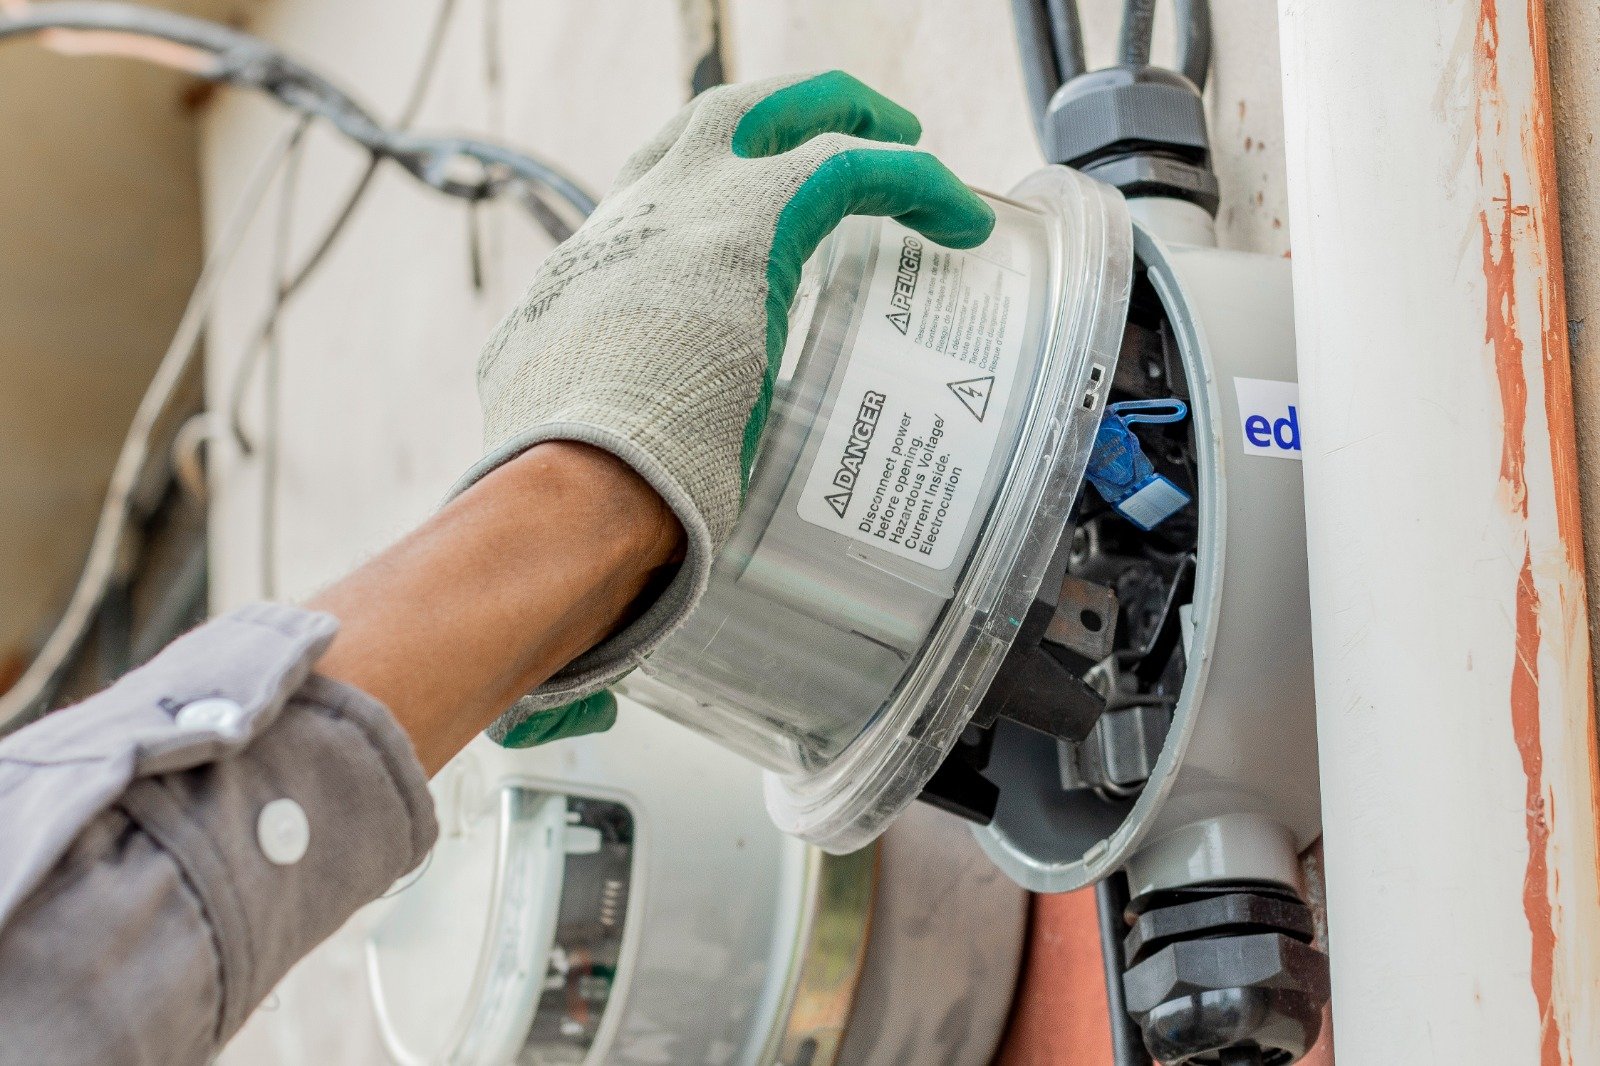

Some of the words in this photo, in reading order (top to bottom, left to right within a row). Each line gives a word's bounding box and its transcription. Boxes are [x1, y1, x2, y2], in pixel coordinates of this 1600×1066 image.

[891, 236, 923, 311] PELIGRO
[833, 390, 886, 490] DANGER
[858, 456, 896, 532] Disconnect
[891, 412, 912, 455] power
[873, 494, 899, 538] before
[895, 433, 923, 493] opening.
[888, 471, 925, 544] Hazardous
[918, 414, 944, 468] Voltage/
[904, 498, 932, 549] Current
[925, 450, 950, 496] Inside.
[920, 465, 962, 554] Electrocution
